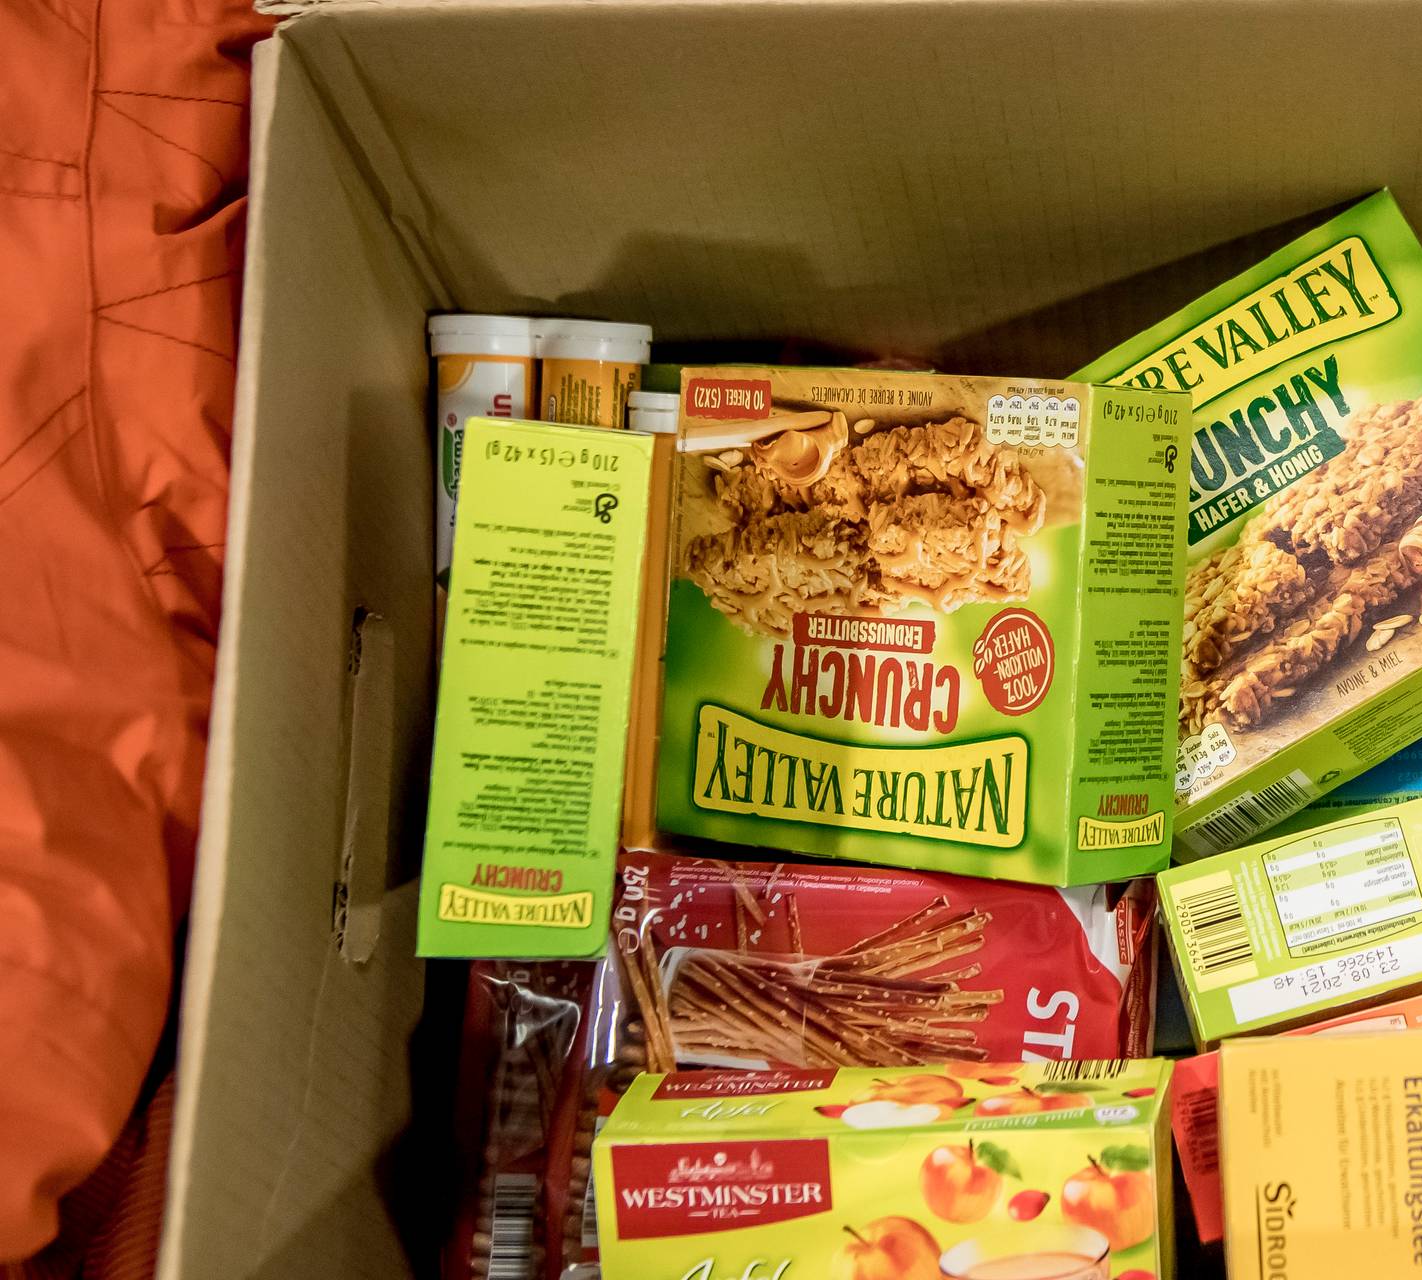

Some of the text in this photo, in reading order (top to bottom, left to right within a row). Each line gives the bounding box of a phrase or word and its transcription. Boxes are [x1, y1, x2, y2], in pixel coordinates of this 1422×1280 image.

[1192, 248, 1375, 369] VALLEY
[693, 386, 765, 409] 10 RIEGEL (5X2)
[857, 388, 865, 402] DE
[869, 388, 894, 404] BEURRE
[898, 390, 903, 405] &
[906, 390, 932, 406] AVOINE
[1102, 400, 1177, 424] 210 (5 x 42 g)
[1188, 353, 1351, 502] UNCHY
[484, 439, 618, 471] 210 g (5 x 42 g)
[1191, 441, 1327, 534] HAFER & HONIG
[806, 615, 923, 650] ERDNUSSBUTTER
[991, 623, 1031, 656] HAFER
[992, 648, 1045, 681] VOLLKORN-
[1333, 649, 1404, 698] AVOINE & MIEL
[759, 642, 961, 734] CRUNCHY
[1002, 671, 1038, 705] 100%
[1184, 739, 1203, 754] Zucker
[1206, 729, 1220, 740] Salz
[1209, 737, 1228, 753] 0.36g
[702, 720, 846, 814] VALLEY
[1190, 748, 1209, 764] 11.3g
[850, 751, 1015, 835] NATURE
[1096, 793, 1148, 816] CRUNCHY
[1080, 815, 1160, 846] NATURE VALLEY
[1363, 846, 1382, 858] Zucker
[1365, 849, 1404, 867] Kohlenhydrate
[469, 862, 564, 892] CRUNCHY
[622, 865, 649, 900] 250
[1401, 878, 1413, 888] Fett
[442, 888, 587, 925] NATURE VALLEY
[1387, 889, 1416, 903] Brennwert
[1287, 921, 1299, 931] kcal
[1333, 909, 1345, 919] kcal
[1116, 900, 1127, 961] CLASSIC
[1176, 904, 1202, 972] 2903 3645
[1300, 915, 1416, 954] Durchschnittliche Nährwerte (zubereitet)
[1335, 945, 1395, 972] 149266
[664, 1071, 824, 1101] WESTMINSTER
[680, 1095, 781, 1125] Apfel
[620, 1182, 823, 1210] WESTMINSTER
